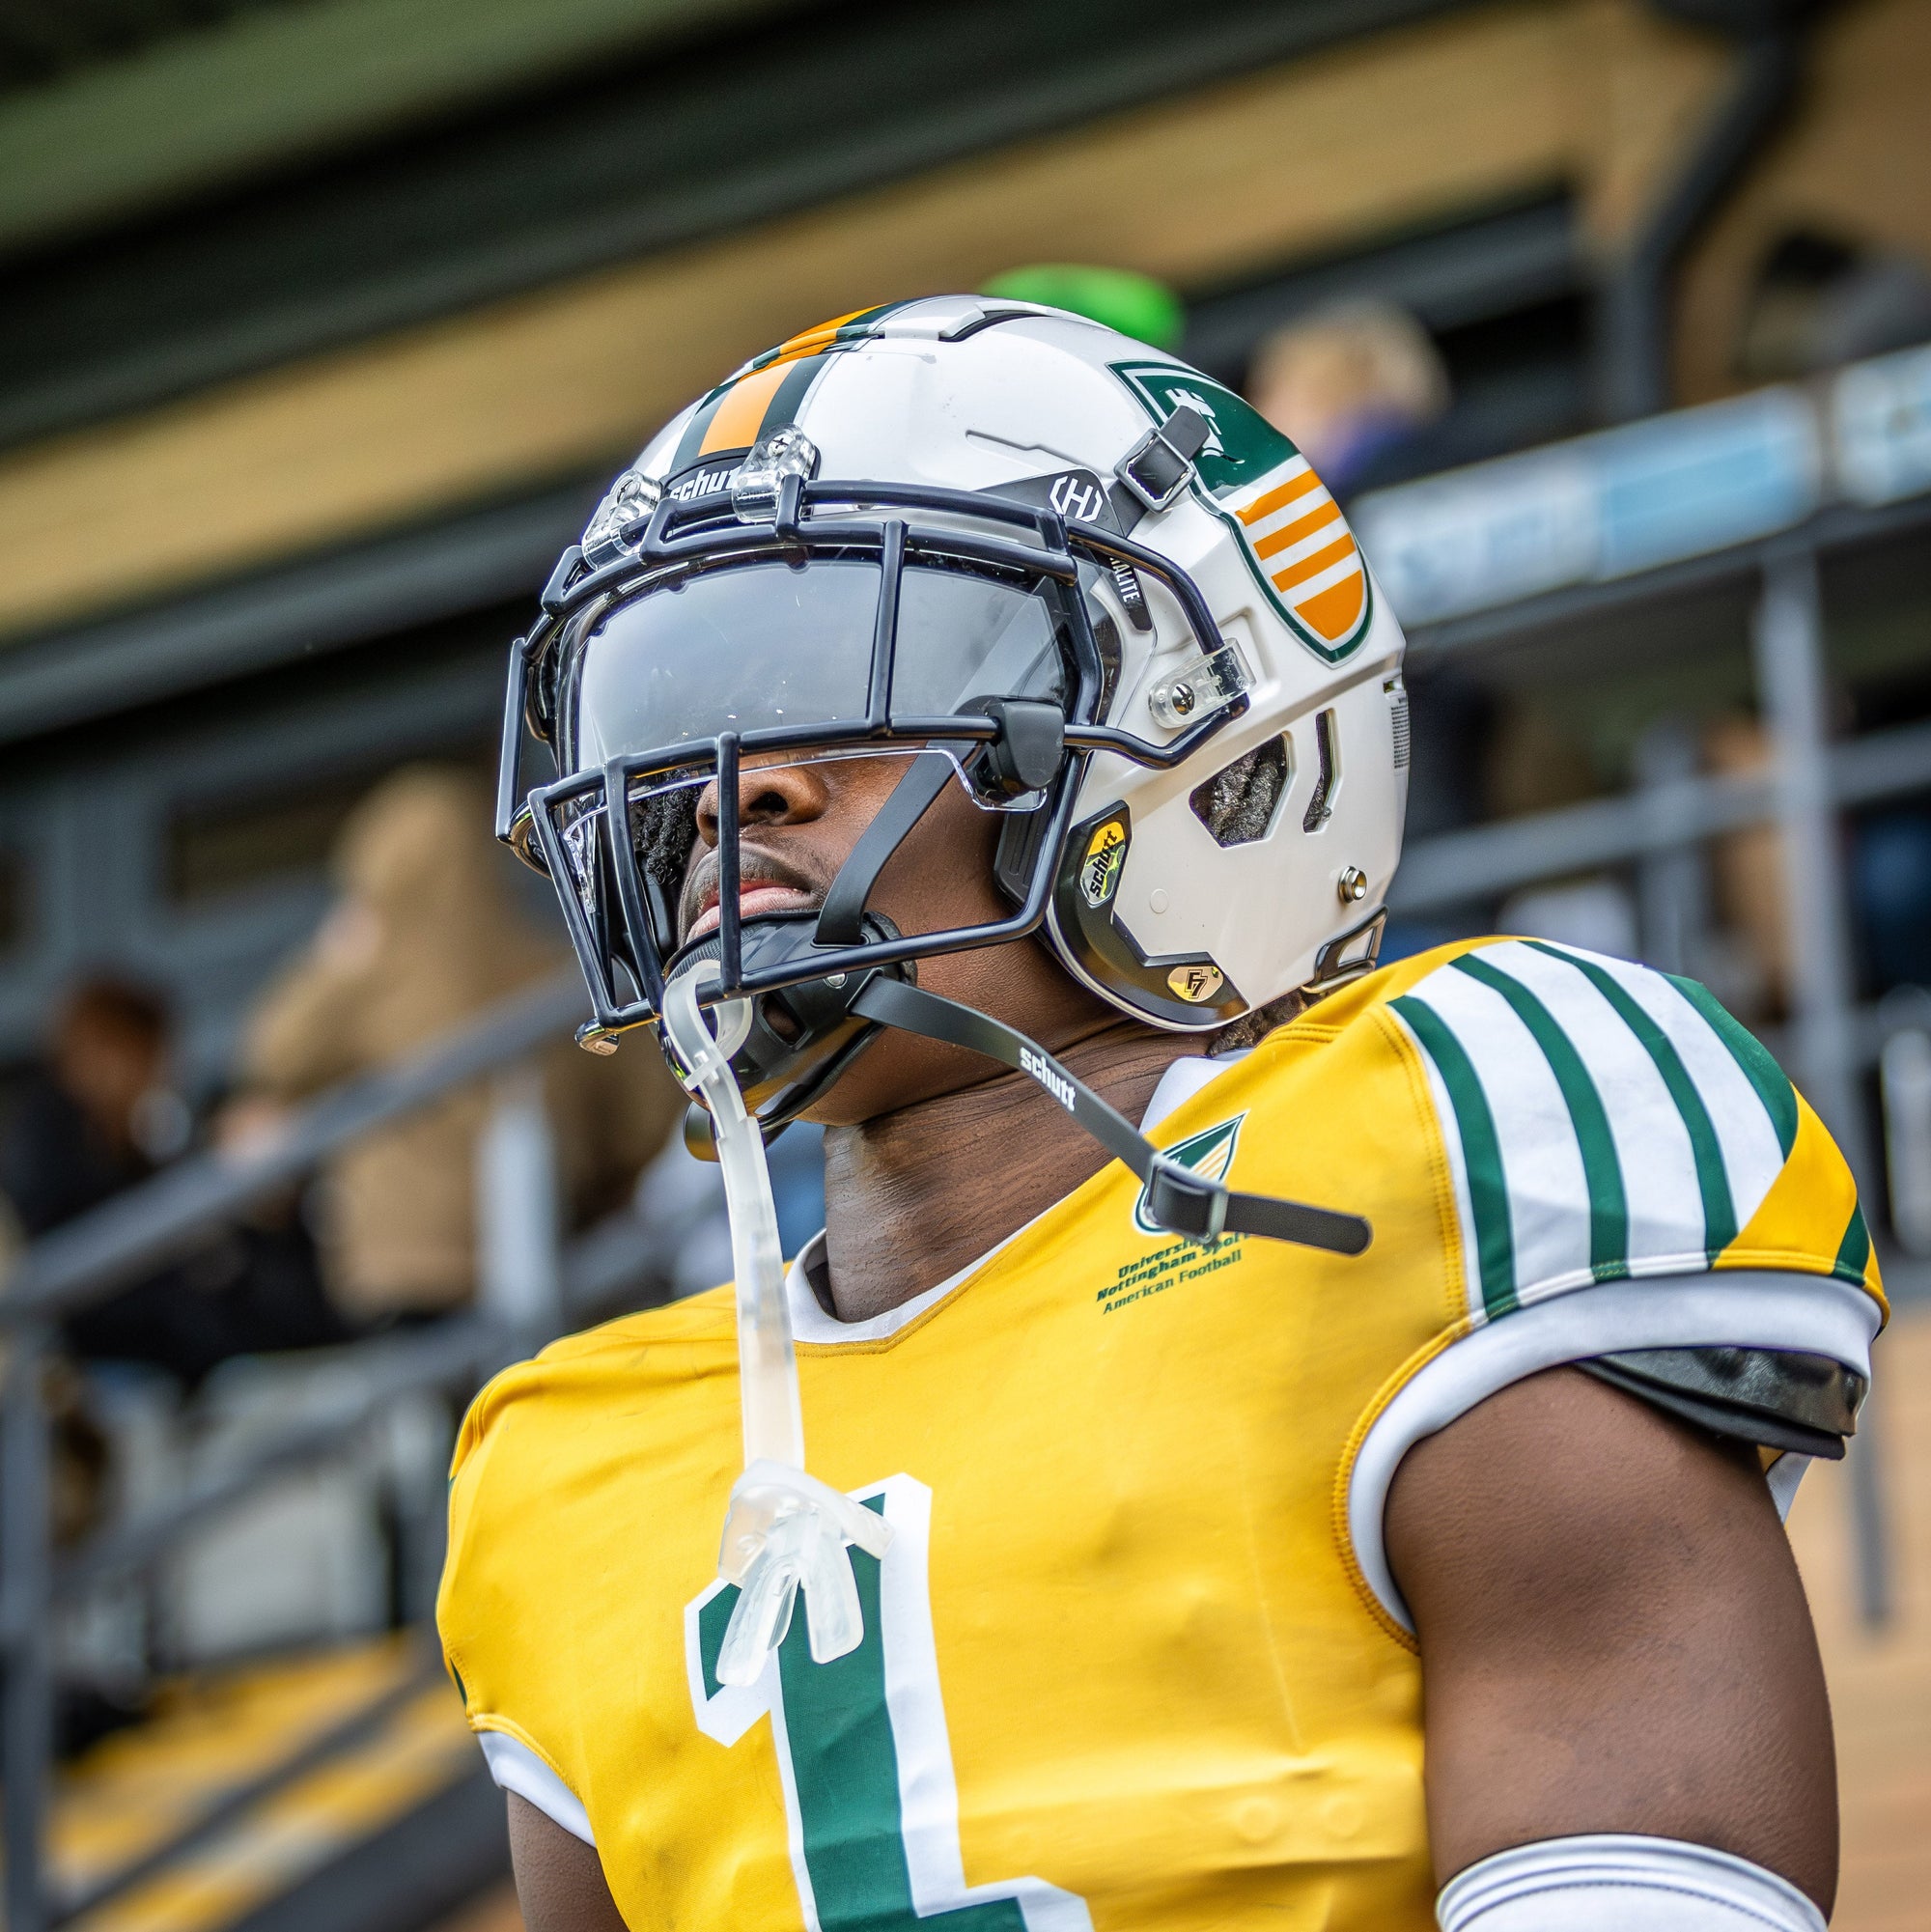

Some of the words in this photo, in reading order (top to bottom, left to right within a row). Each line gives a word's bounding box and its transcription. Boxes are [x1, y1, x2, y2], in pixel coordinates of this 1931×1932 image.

[670, 464, 744, 500] schut
[1089, 830, 1117, 898] schutt
[1020, 1047, 1076, 1112] schutt
[1096, 1251, 1197, 1302] Nottingham
[1103, 1277, 1174, 1316] American
[1179, 1249, 1243, 1284] Football
